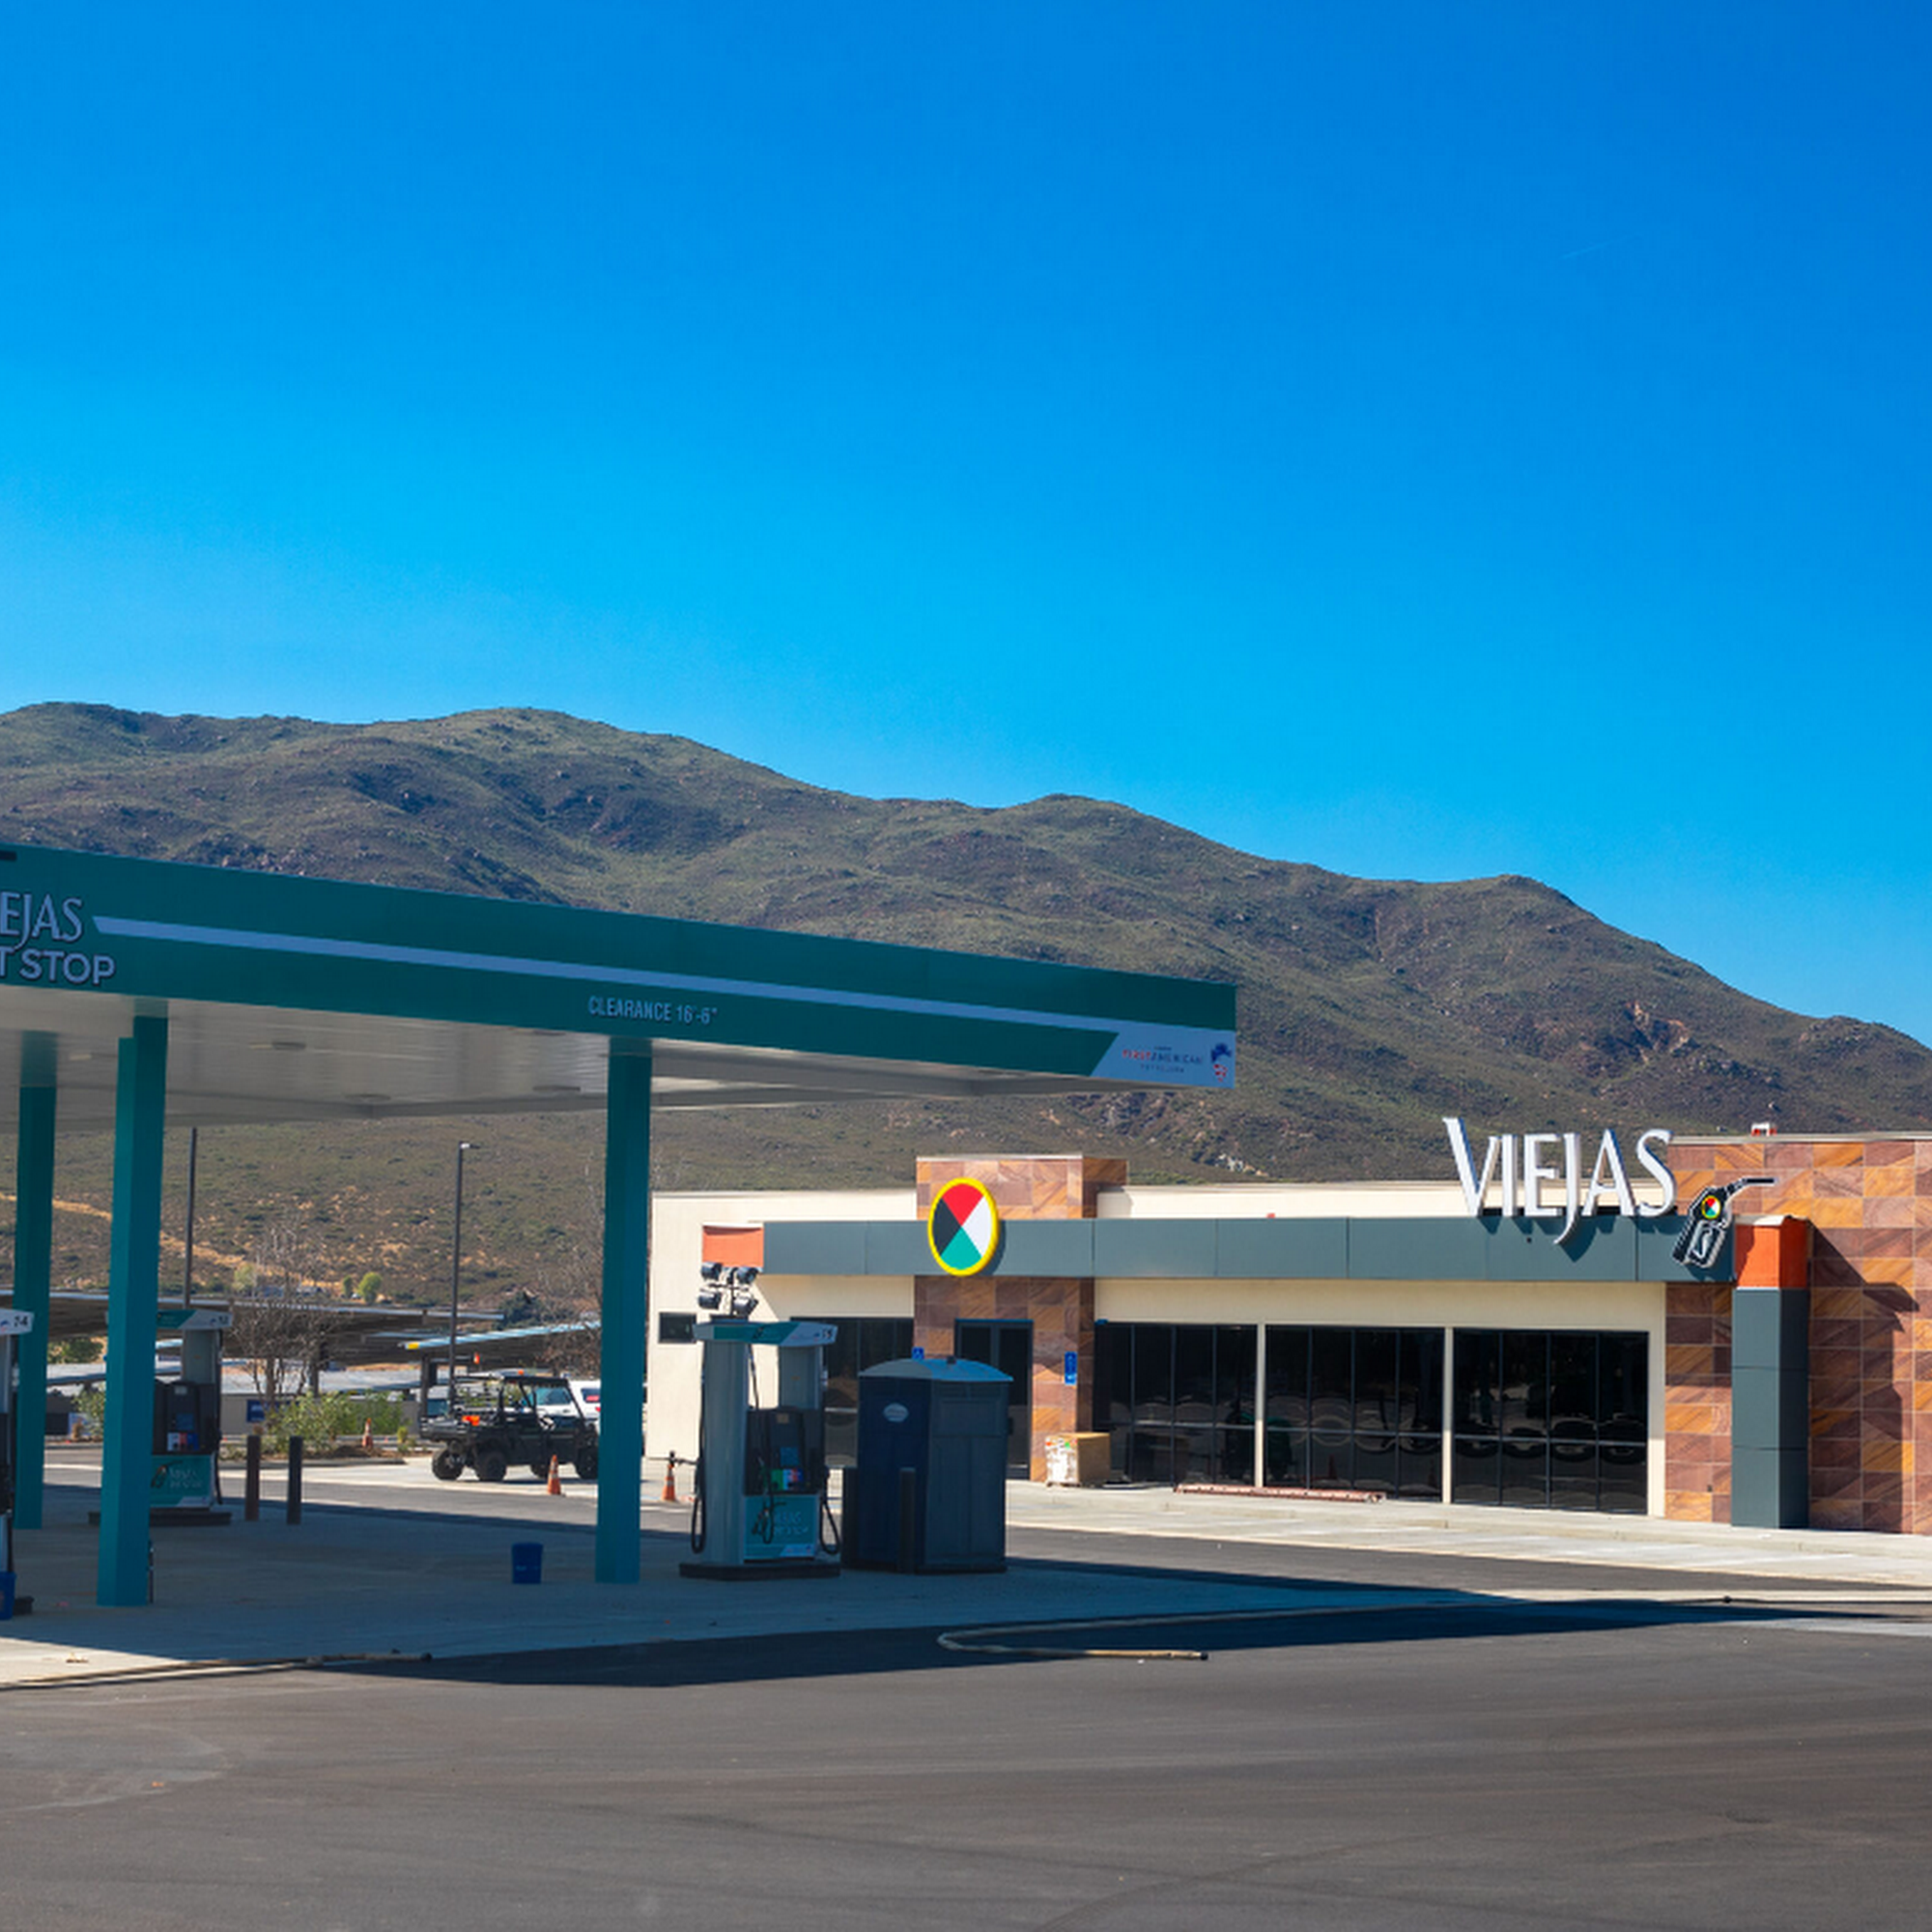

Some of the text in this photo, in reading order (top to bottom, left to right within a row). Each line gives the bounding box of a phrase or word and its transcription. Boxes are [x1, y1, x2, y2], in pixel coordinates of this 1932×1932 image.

[19, 948, 117, 985] STOP
[587, 995, 672, 1022] CLEARANCE
[1442, 1117, 1678, 1244] VIEJAS
